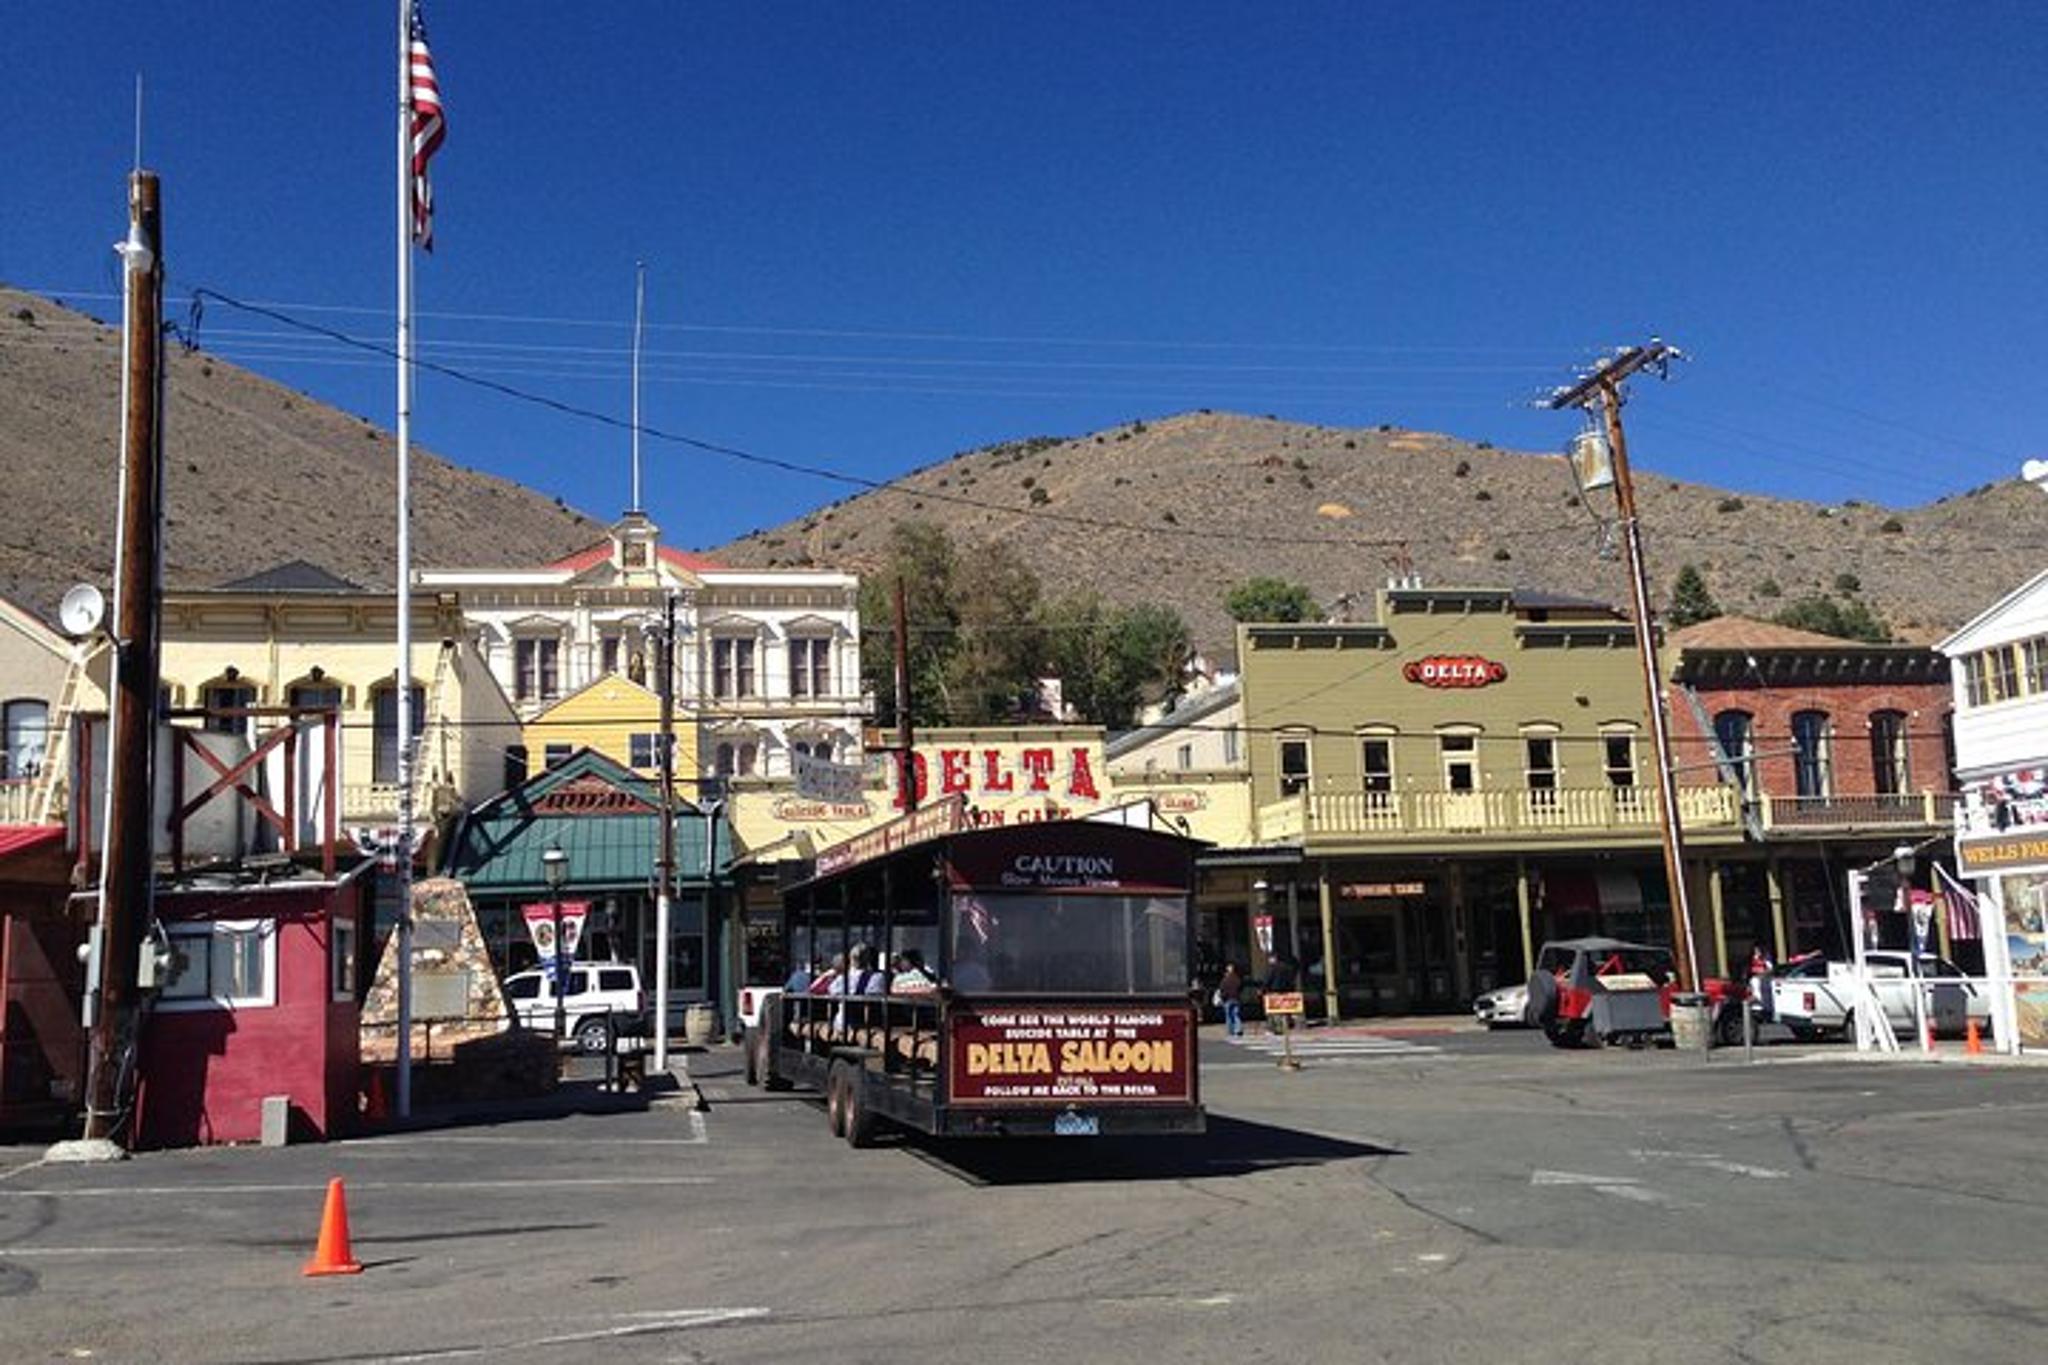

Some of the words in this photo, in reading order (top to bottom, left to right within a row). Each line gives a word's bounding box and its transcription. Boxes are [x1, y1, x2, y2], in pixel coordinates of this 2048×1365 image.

[1423, 664, 1487, 678] DELTA
[891, 747, 1100, 808] DELTA
[1963, 844, 2018, 863] WELLS
[1015, 855, 1113, 874] CAUTION
[981, 1014, 1016, 1026] COME
[1019, 1014, 1039, 1026] SEE
[1043, 1014, 1065, 1026] THE
[1068, 1014, 1111, 1026] WORLD
[1114, 1013, 1163, 1026] FAMOUS
[1005, 1028, 1053, 1039] SUICIDE
[1055, 1028, 1091, 1039] TABLE
[1093, 1028, 1108, 1039] AT
[1114, 1028, 1137, 1039] THE
[967, 1042, 1053, 1075] DELTA
[1060, 1040, 1173, 1073] SALOON
[983, 1085, 1031, 1096] FOLLOW
[1051, 1085, 1081, 1096] BACK
